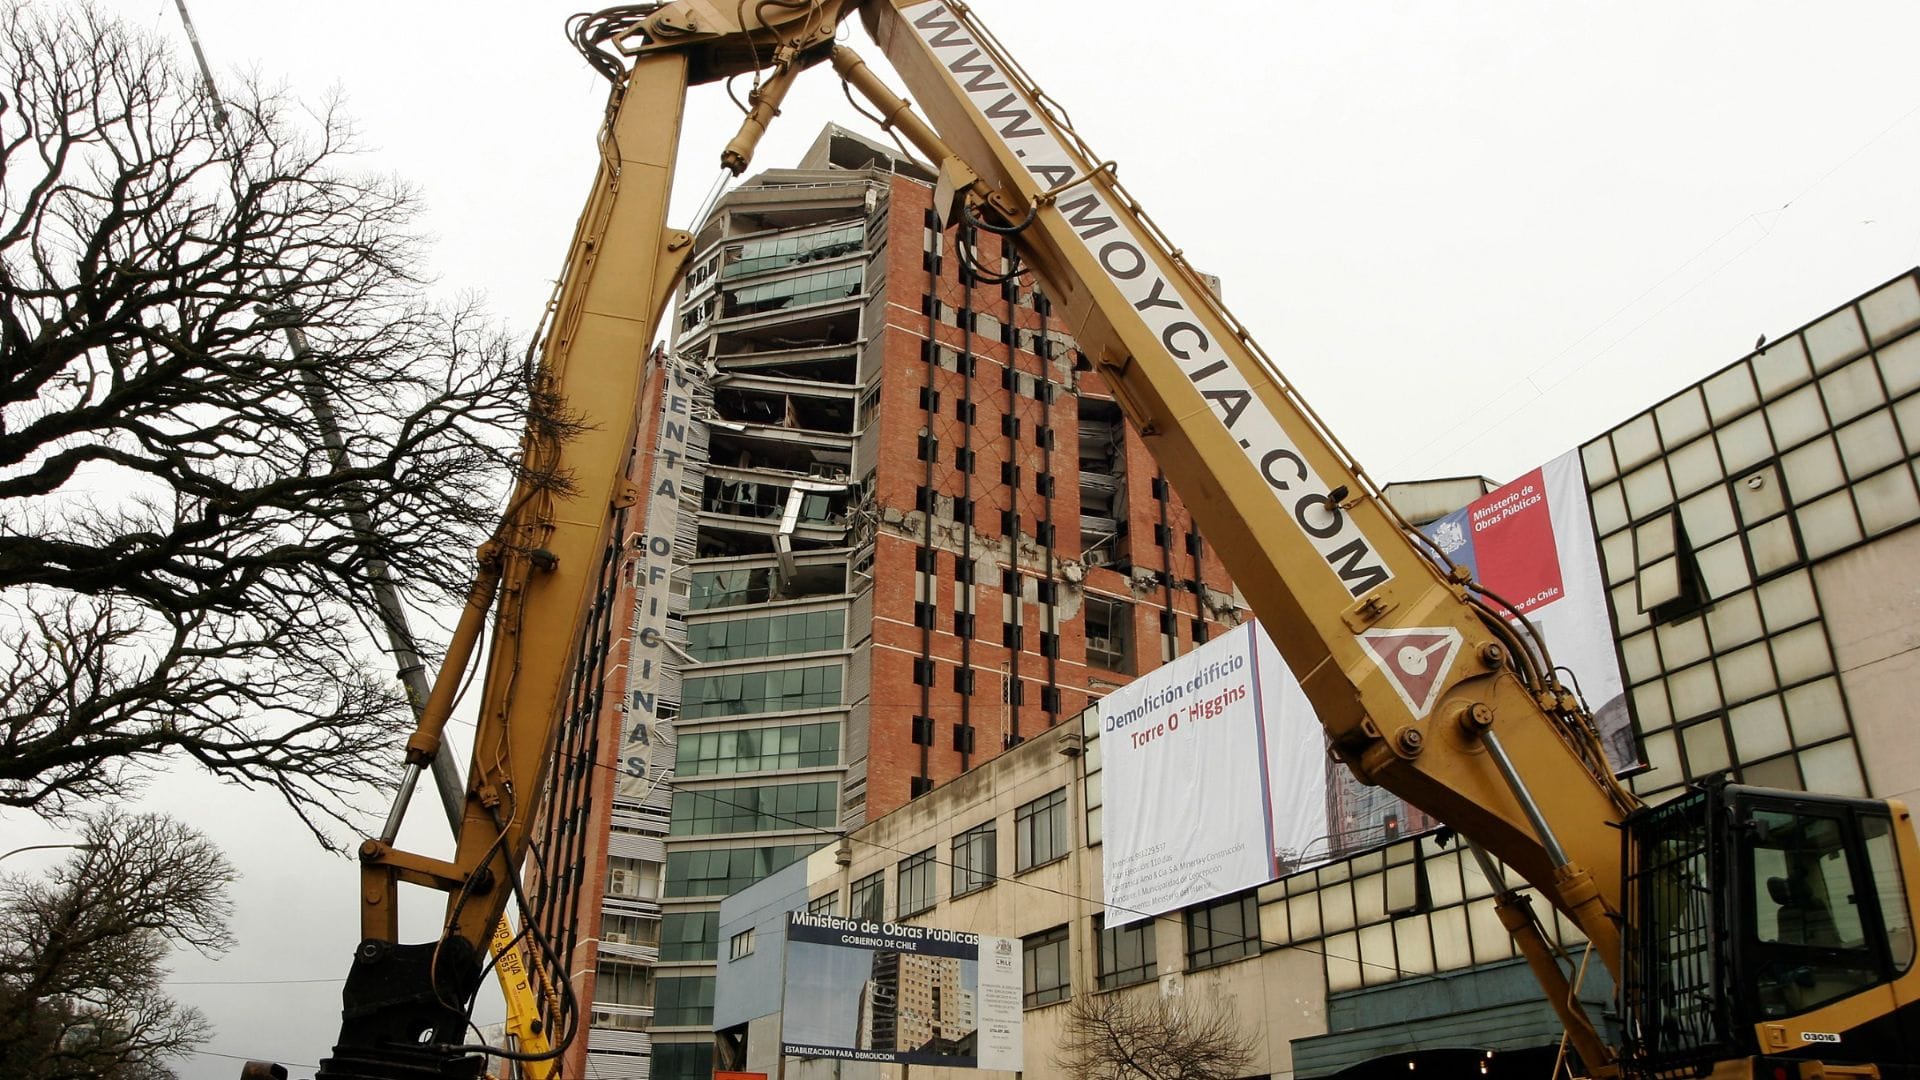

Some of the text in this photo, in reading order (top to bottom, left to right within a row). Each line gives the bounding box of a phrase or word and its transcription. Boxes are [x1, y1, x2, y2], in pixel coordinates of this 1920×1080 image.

[656, 368, 689, 499] VENTA
[1473, 484, 1534, 521] Ministerio de
[1475, 493, 1542, 532] Obras Públicas
[1526, 597, 1537, 606] de
[1537, 587, 1558, 601] Chile
[626, 535, 671, 779] OFICINAS
[1105, 655, 1244, 732] Demolición edificio
[1131, 724, 1164, 751] Torre
[791, 911, 980, 946] Ministerio de Obras Públicas
[841, 934, 917, 951] GOBIERNO DE CHILE
[507, 952, 522, 976] EIVA
[784, 1045, 895, 1061] ESTABILIZACION PARA DEMOLICION
